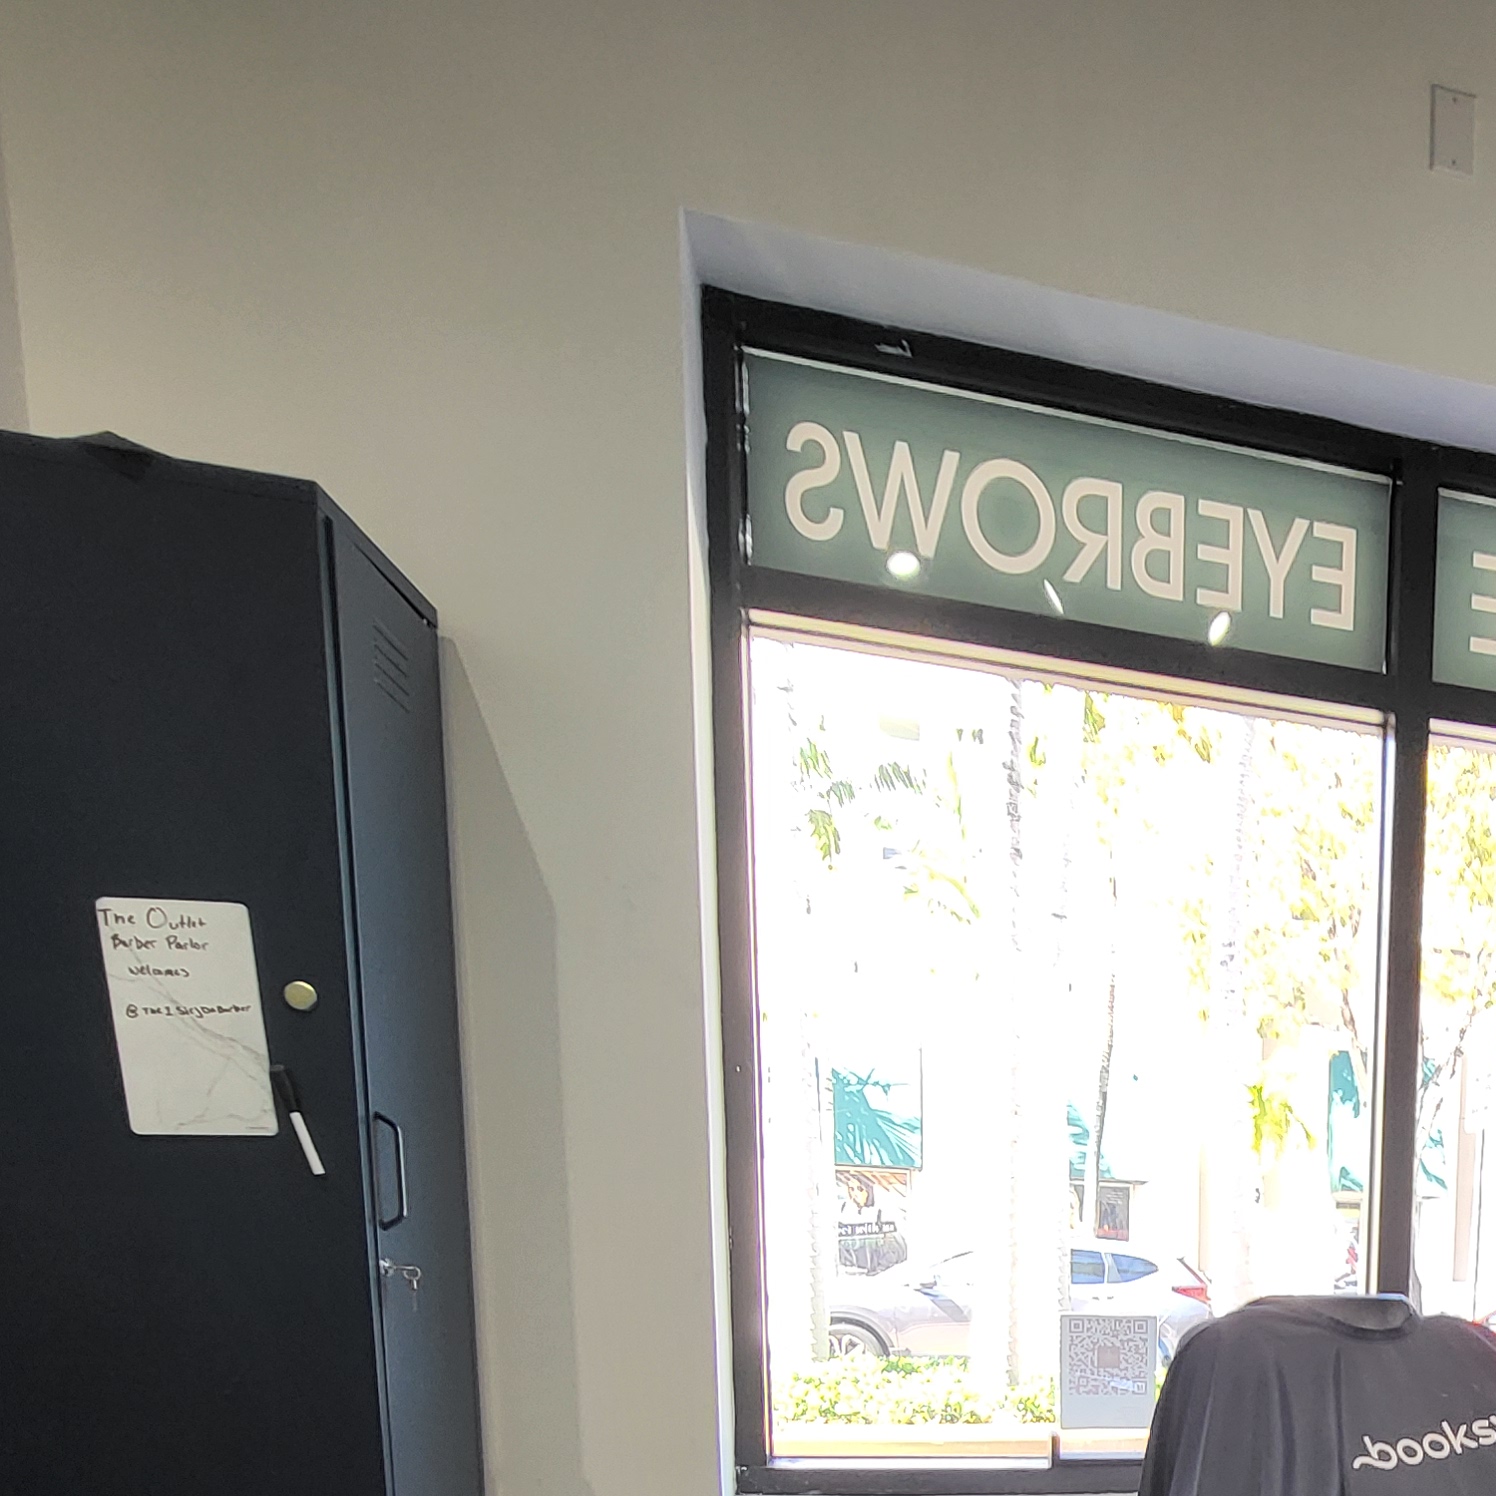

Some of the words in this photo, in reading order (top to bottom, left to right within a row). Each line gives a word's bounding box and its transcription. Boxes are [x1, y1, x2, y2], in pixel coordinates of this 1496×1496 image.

[146, 906, 208, 930] Outlet
[111, 933, 157, 950] Barber
[165, 935, 209, 951] Parlor
